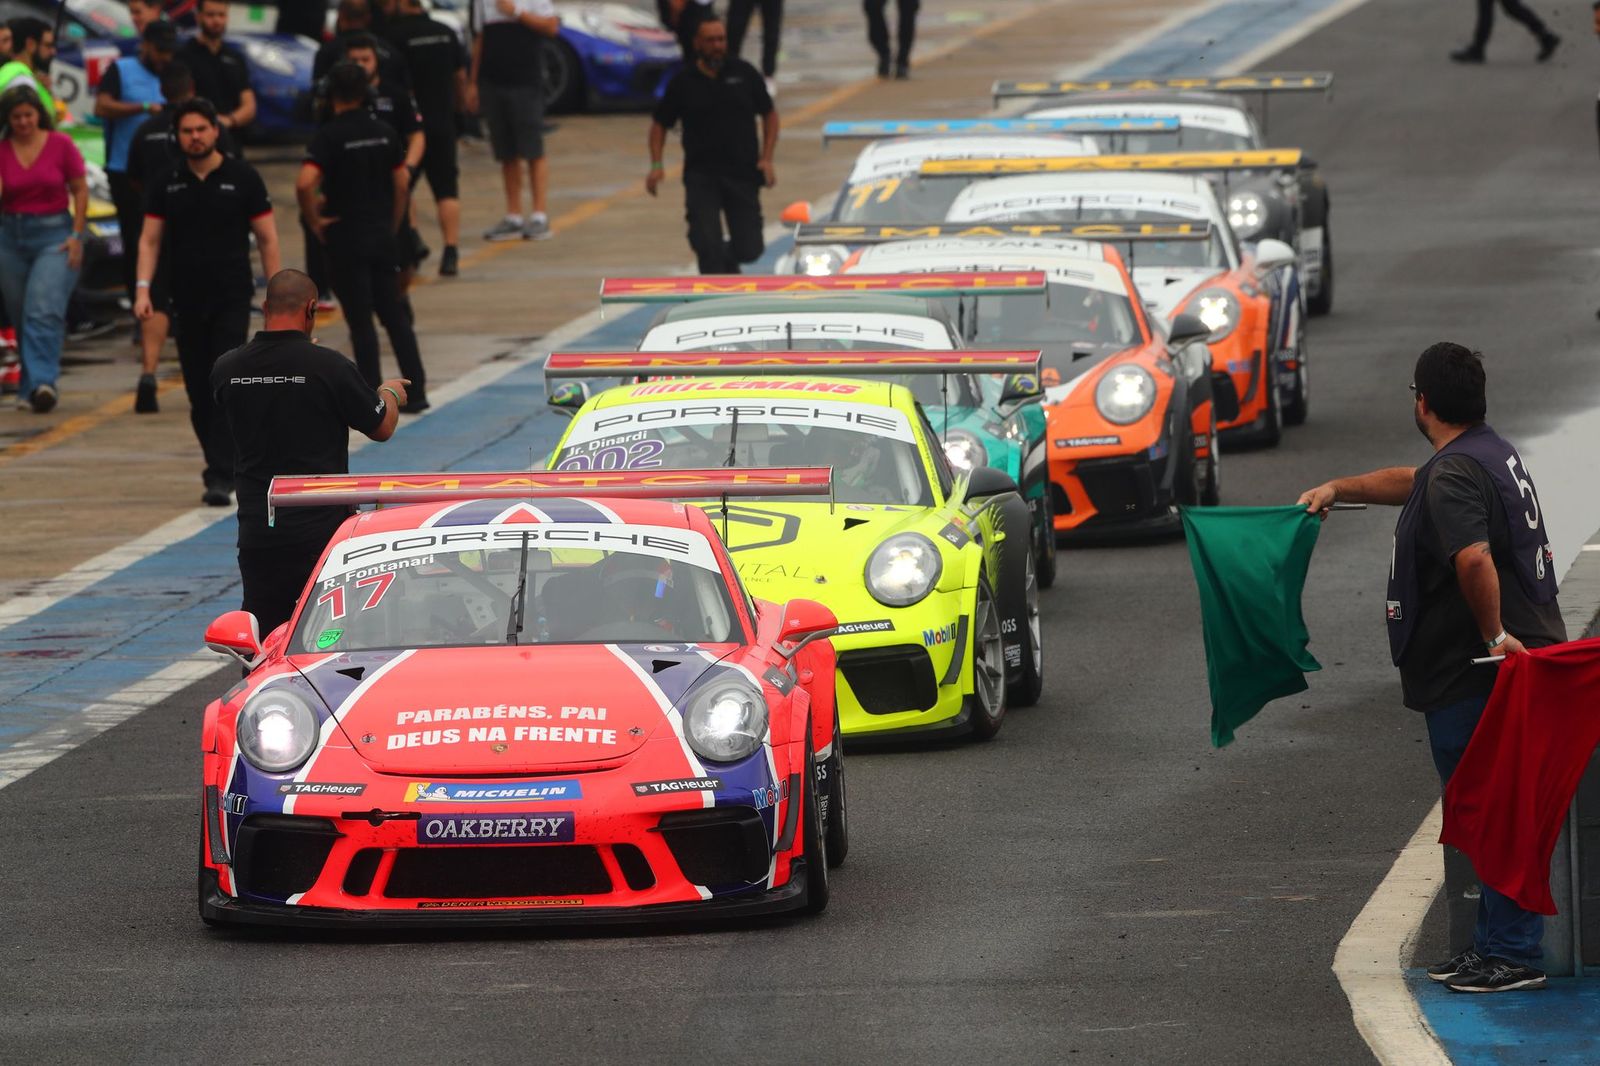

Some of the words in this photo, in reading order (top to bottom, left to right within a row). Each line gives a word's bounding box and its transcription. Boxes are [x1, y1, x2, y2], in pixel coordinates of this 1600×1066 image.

[968, 194, 1201, 216] PORSCHE
[675, 322, 925, 345] PORSCHE
[230, 376, 306, 385] PORSCHE
[593, 404, 898, 433] PORSCHE
[566, 447, 584, 458] Jr.
[588, 430, 648, 451] Dinardi
[301, 473, 801, 493] ZMATCH
[342, 529, 690, 566] PORSCHE
[323, 578, 341, 591] R.
[345, 554, 435, 583] Fontanari
[317, 571, 397, 621] 17
[834, 621, 891, 634] AGHeuer
[559, 705, 607, 721] PAI
[386, 728, 461, 750] DEUS
[468, 726, 507, 743] NA
[513, 726, 617, 745] FRENTE
[453, 786, 567, 798] MICHELIN
[425, 817, 565, 839] OAKBERRY
